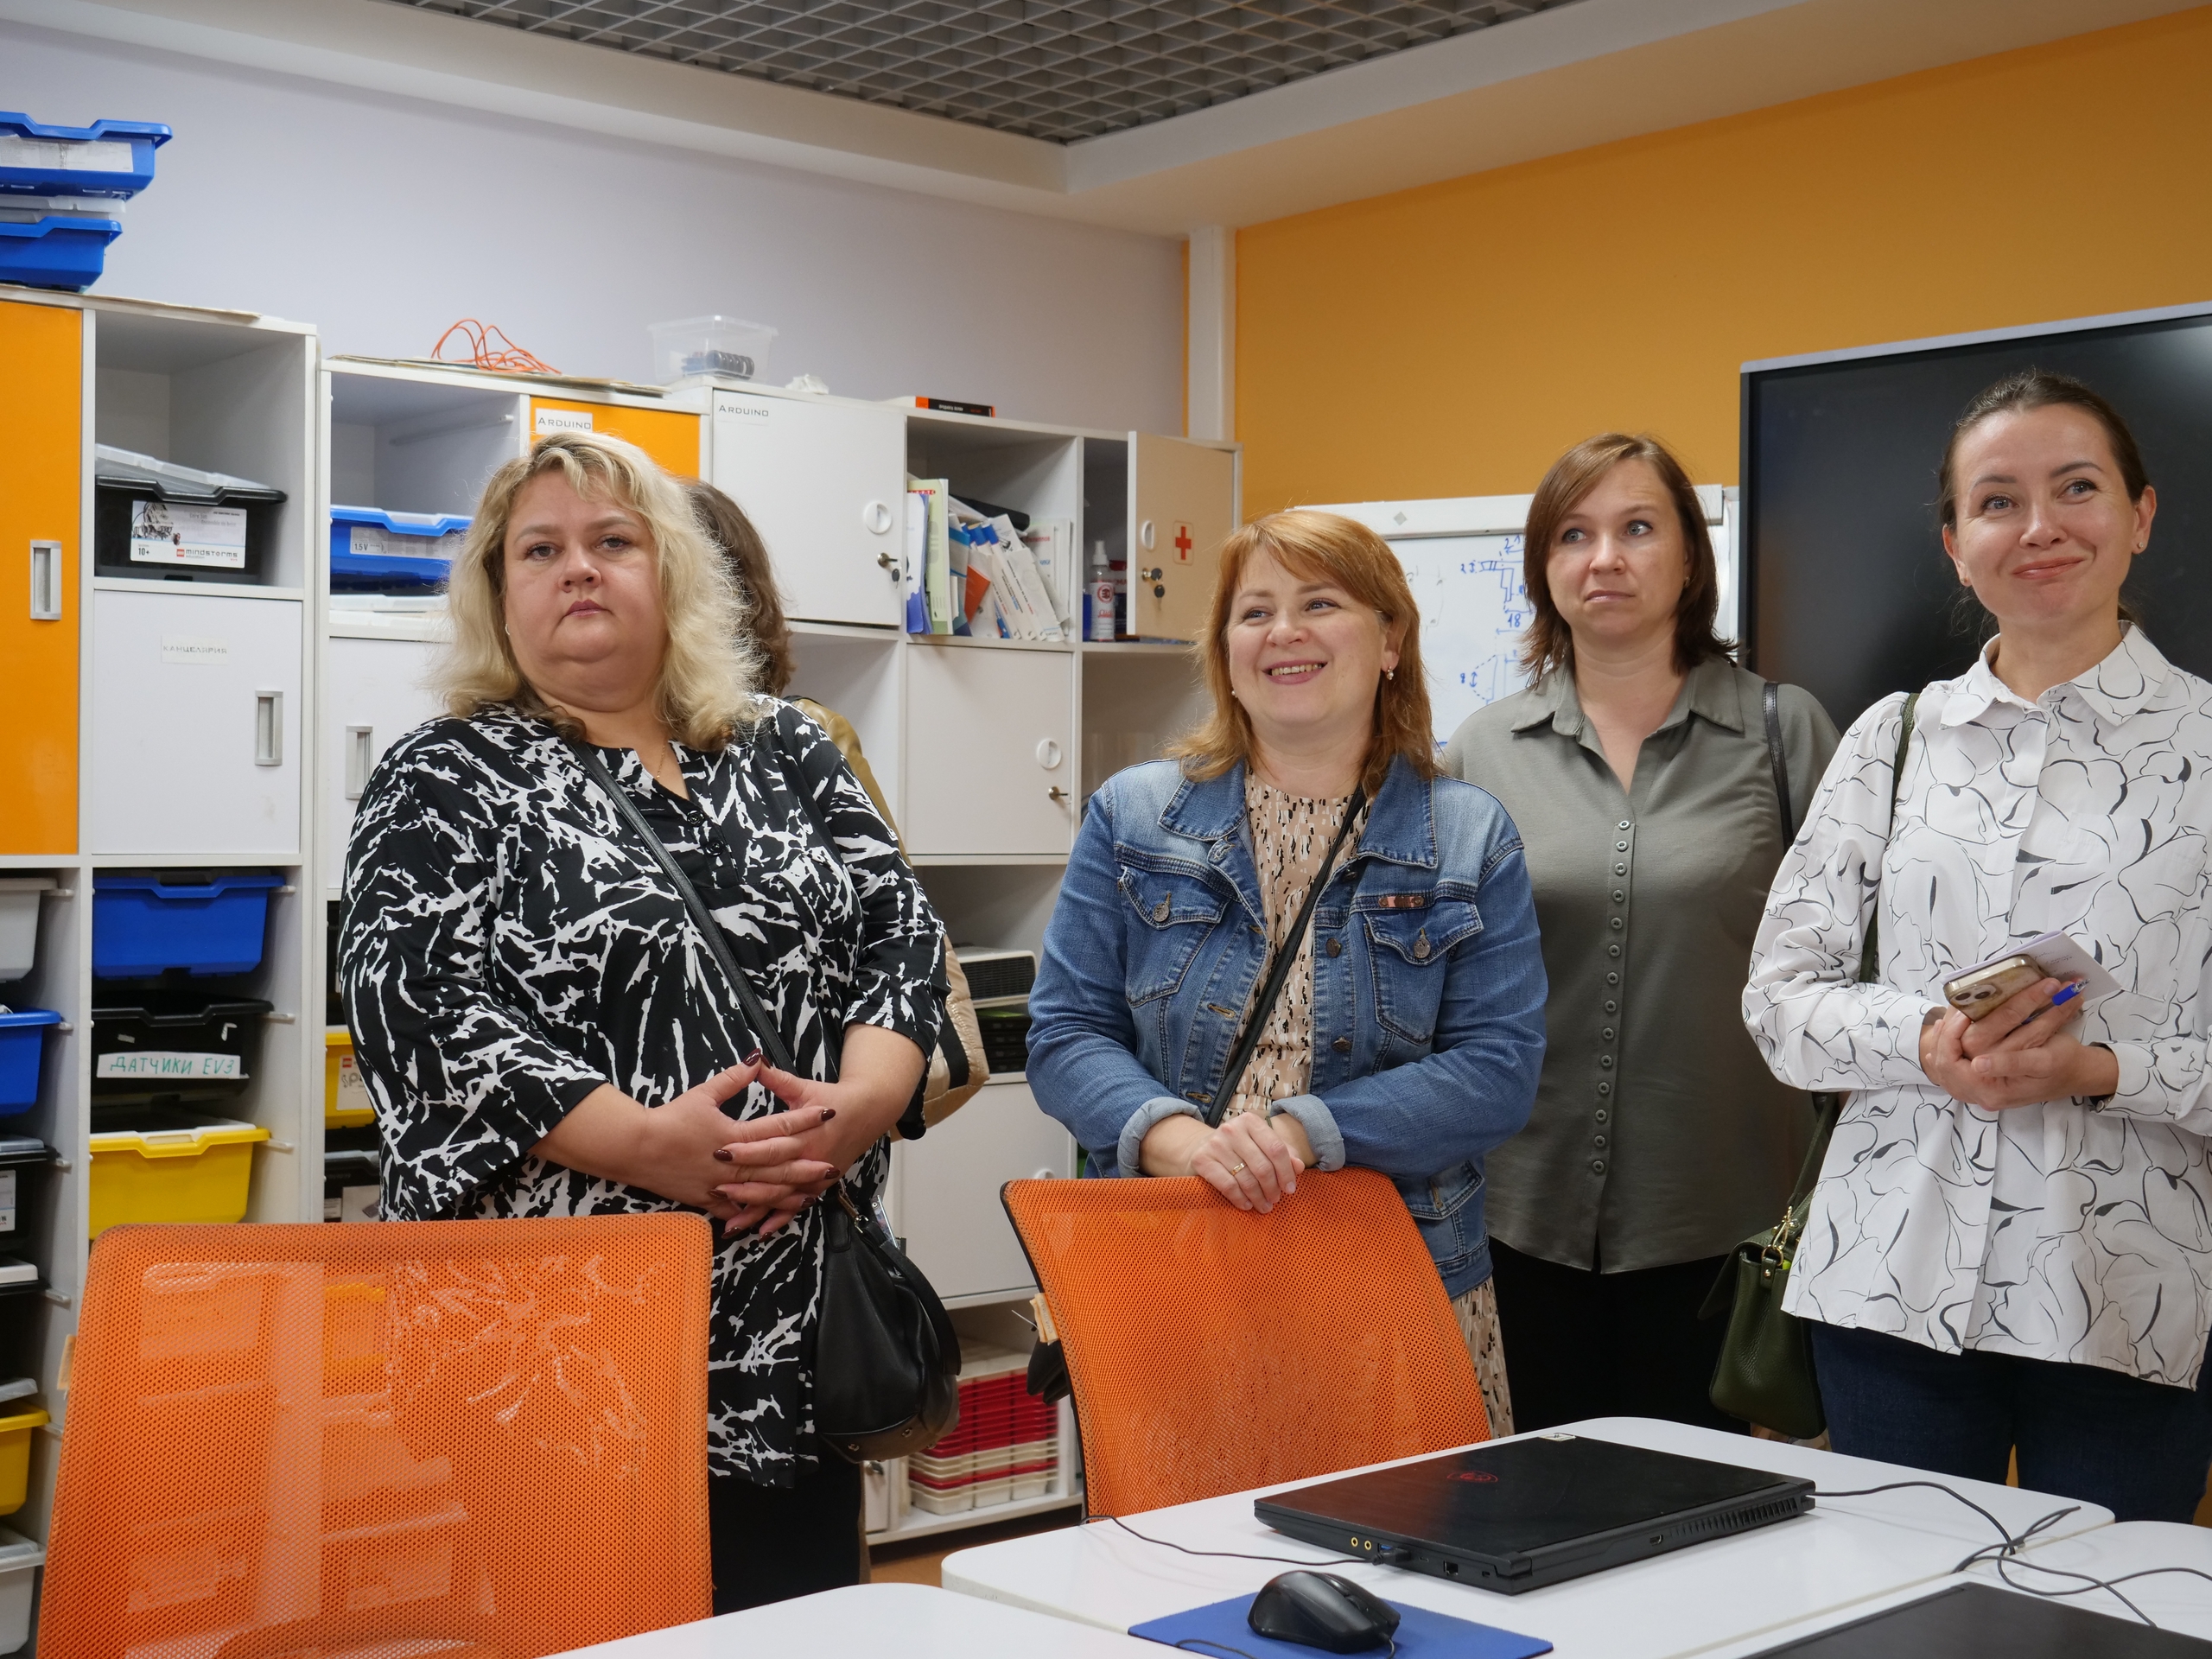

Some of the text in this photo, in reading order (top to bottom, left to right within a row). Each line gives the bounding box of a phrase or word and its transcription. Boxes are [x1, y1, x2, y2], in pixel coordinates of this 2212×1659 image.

[719, 404, 769, 417] ARDUINO
[537, 416, 592, 429] ARDUINO
[138, 547, 150, 556] 10+
[1507, 613, 1521, 628] 18
[162, 645, 227, 654] КАНЦЕЛЯРИЯ
[110, 1056, 235, 1075] ДАТЧИКИ EV3
